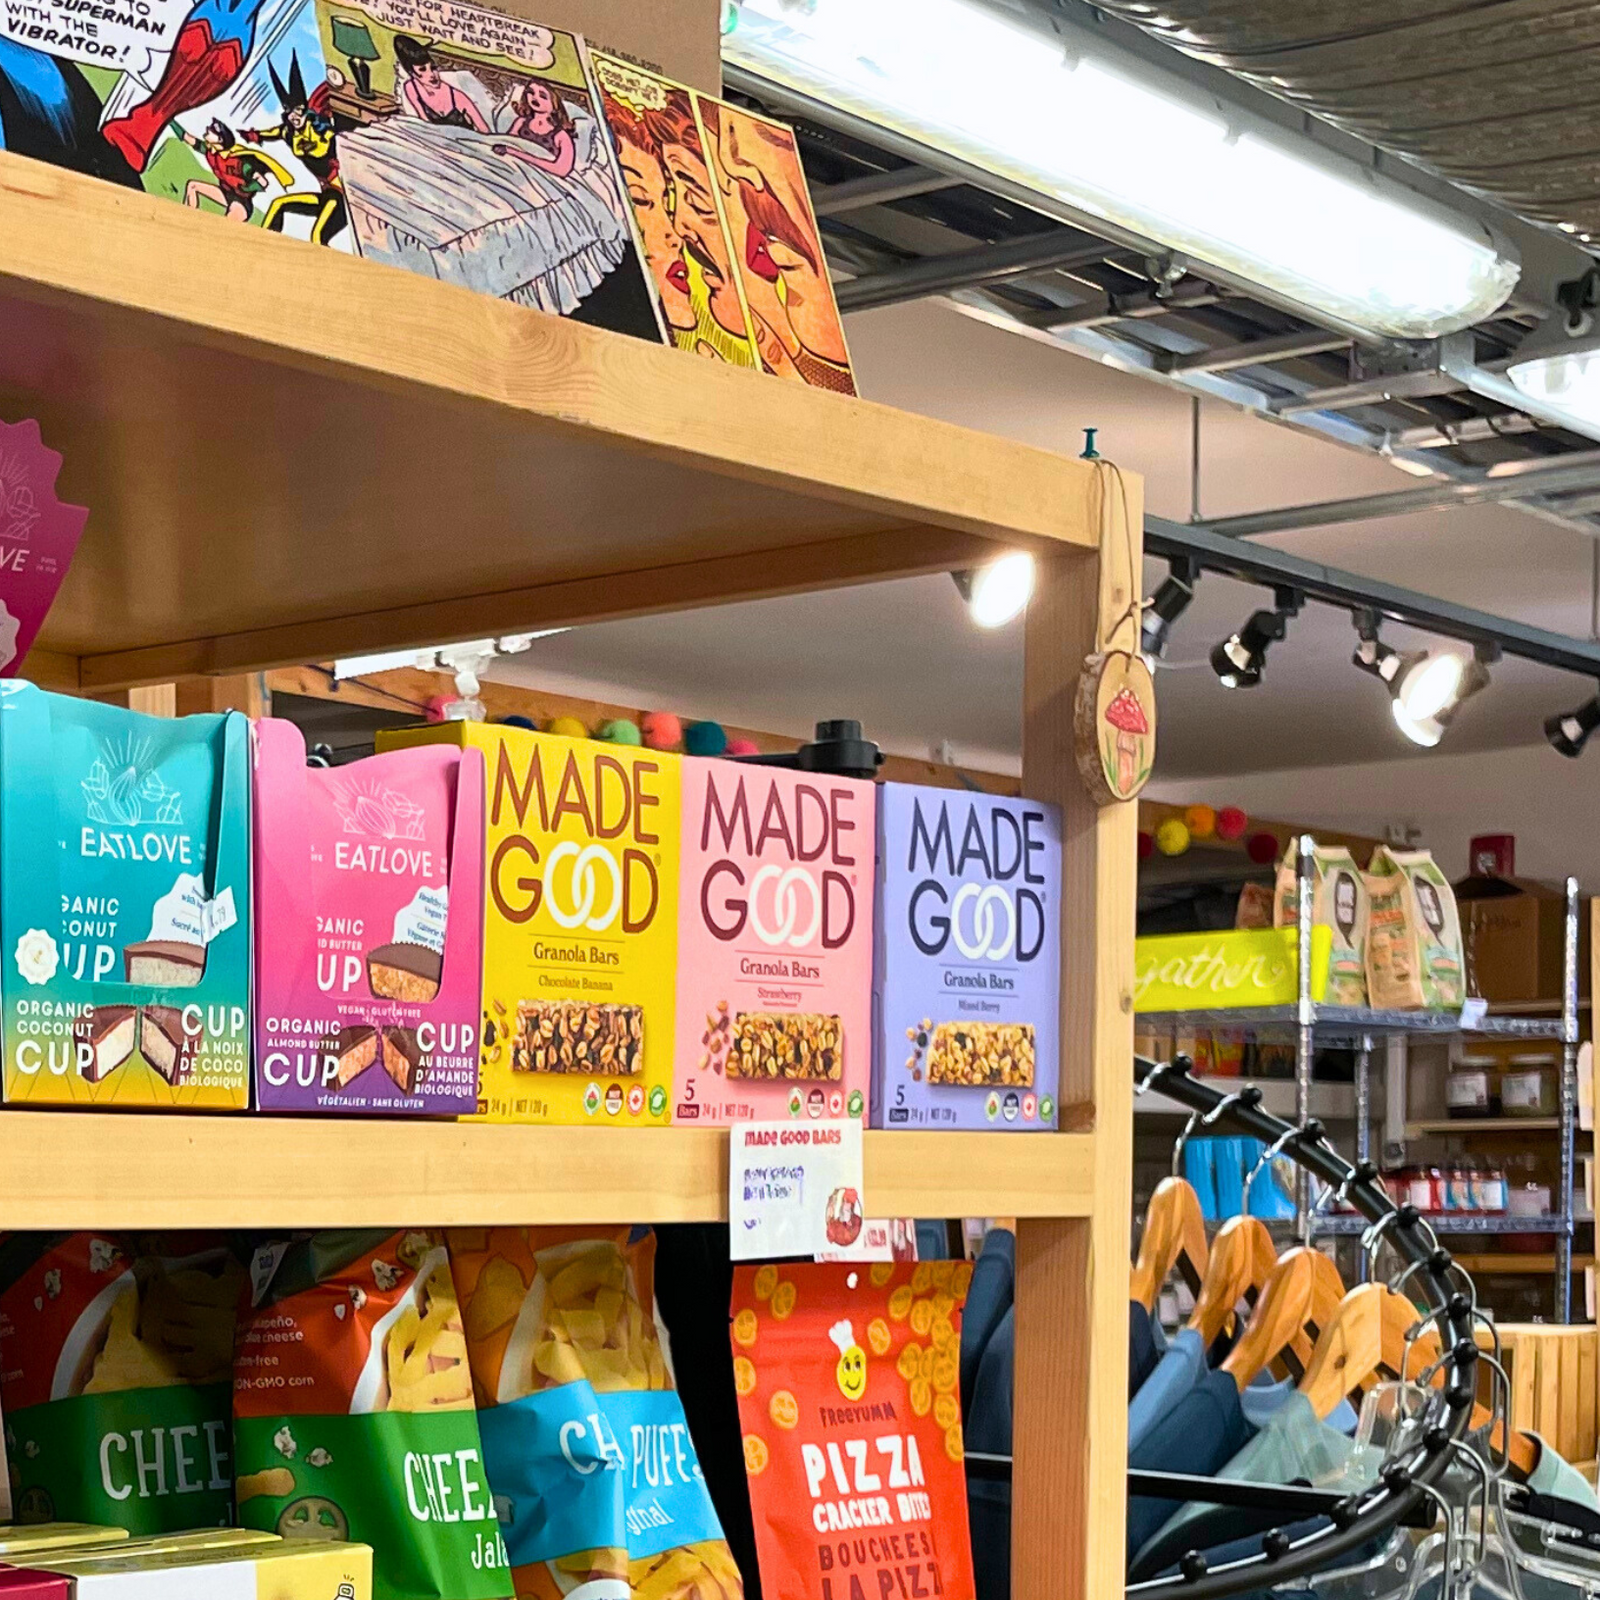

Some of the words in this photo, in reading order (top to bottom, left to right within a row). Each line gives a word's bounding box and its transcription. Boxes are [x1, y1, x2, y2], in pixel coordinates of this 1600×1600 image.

[7, 4, 53, 27] WITH
[58, 15, 99, 36] THE
[7, 18, 132, 61] VIBRATOR!
[460, 34, 496, 49] AND
[491, 738, 659, 845] MADE
[701, 770, 855, 866] MADE
[80, 826, 191, 864] EATLOVE
[908, 796, 1044, 884] MADE
[335, 842, 433, 878] EATLOVE
[491, 834, 659, 934] GOOD
[701, 859, 855, 949] GOOD
[908, 879, 1044, 962] GOOD
[534, 942, 586, 965] Granola
[590, 945, 620, 966] Bars
[740, 958, 788, 979] Granola
[792, 962, 820, 980] Bars
[16, 1001, 94, 1018] ORGANIC
[181, 1004, 245, 1037] CUP
[17, 1021, 94, 1037] COCONUT
[16, 1039, 95, 1076] CUP
[781, 1130, 809, 1145] GOOD
[812, 1130, 841, 1145] BARS
[802, 1434, 925, 1497] PIZZA
[813, 1497, 893, 1532] CRACKER
